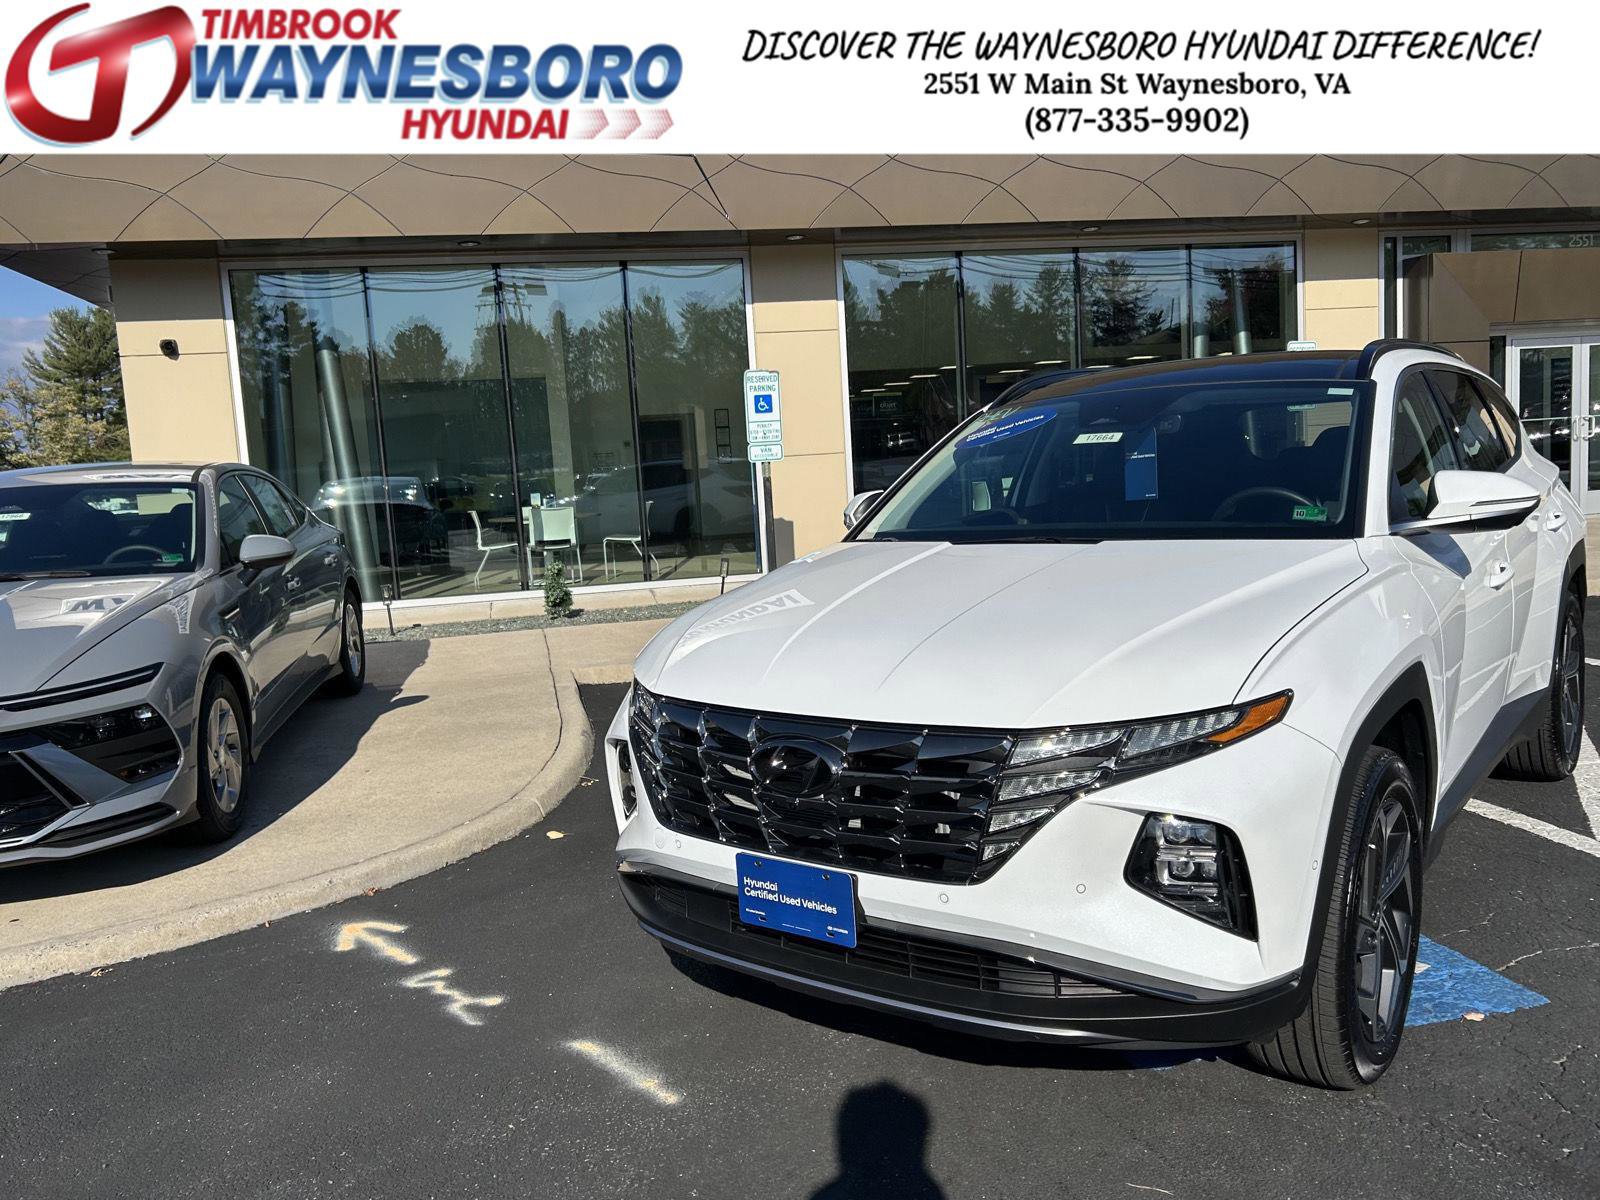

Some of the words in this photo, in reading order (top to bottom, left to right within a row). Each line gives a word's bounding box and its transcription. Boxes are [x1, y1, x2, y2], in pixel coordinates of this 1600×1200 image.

[1568, 233, 1594, 247] 2551
[746, 374, 778, 383] RESERVED
[743, 876, 778, 892] Hyundai
[744, 887, 779, 902] Certified
[779, 894, 801, 907] Used
[801, 898, 838, 915] Vehicles
